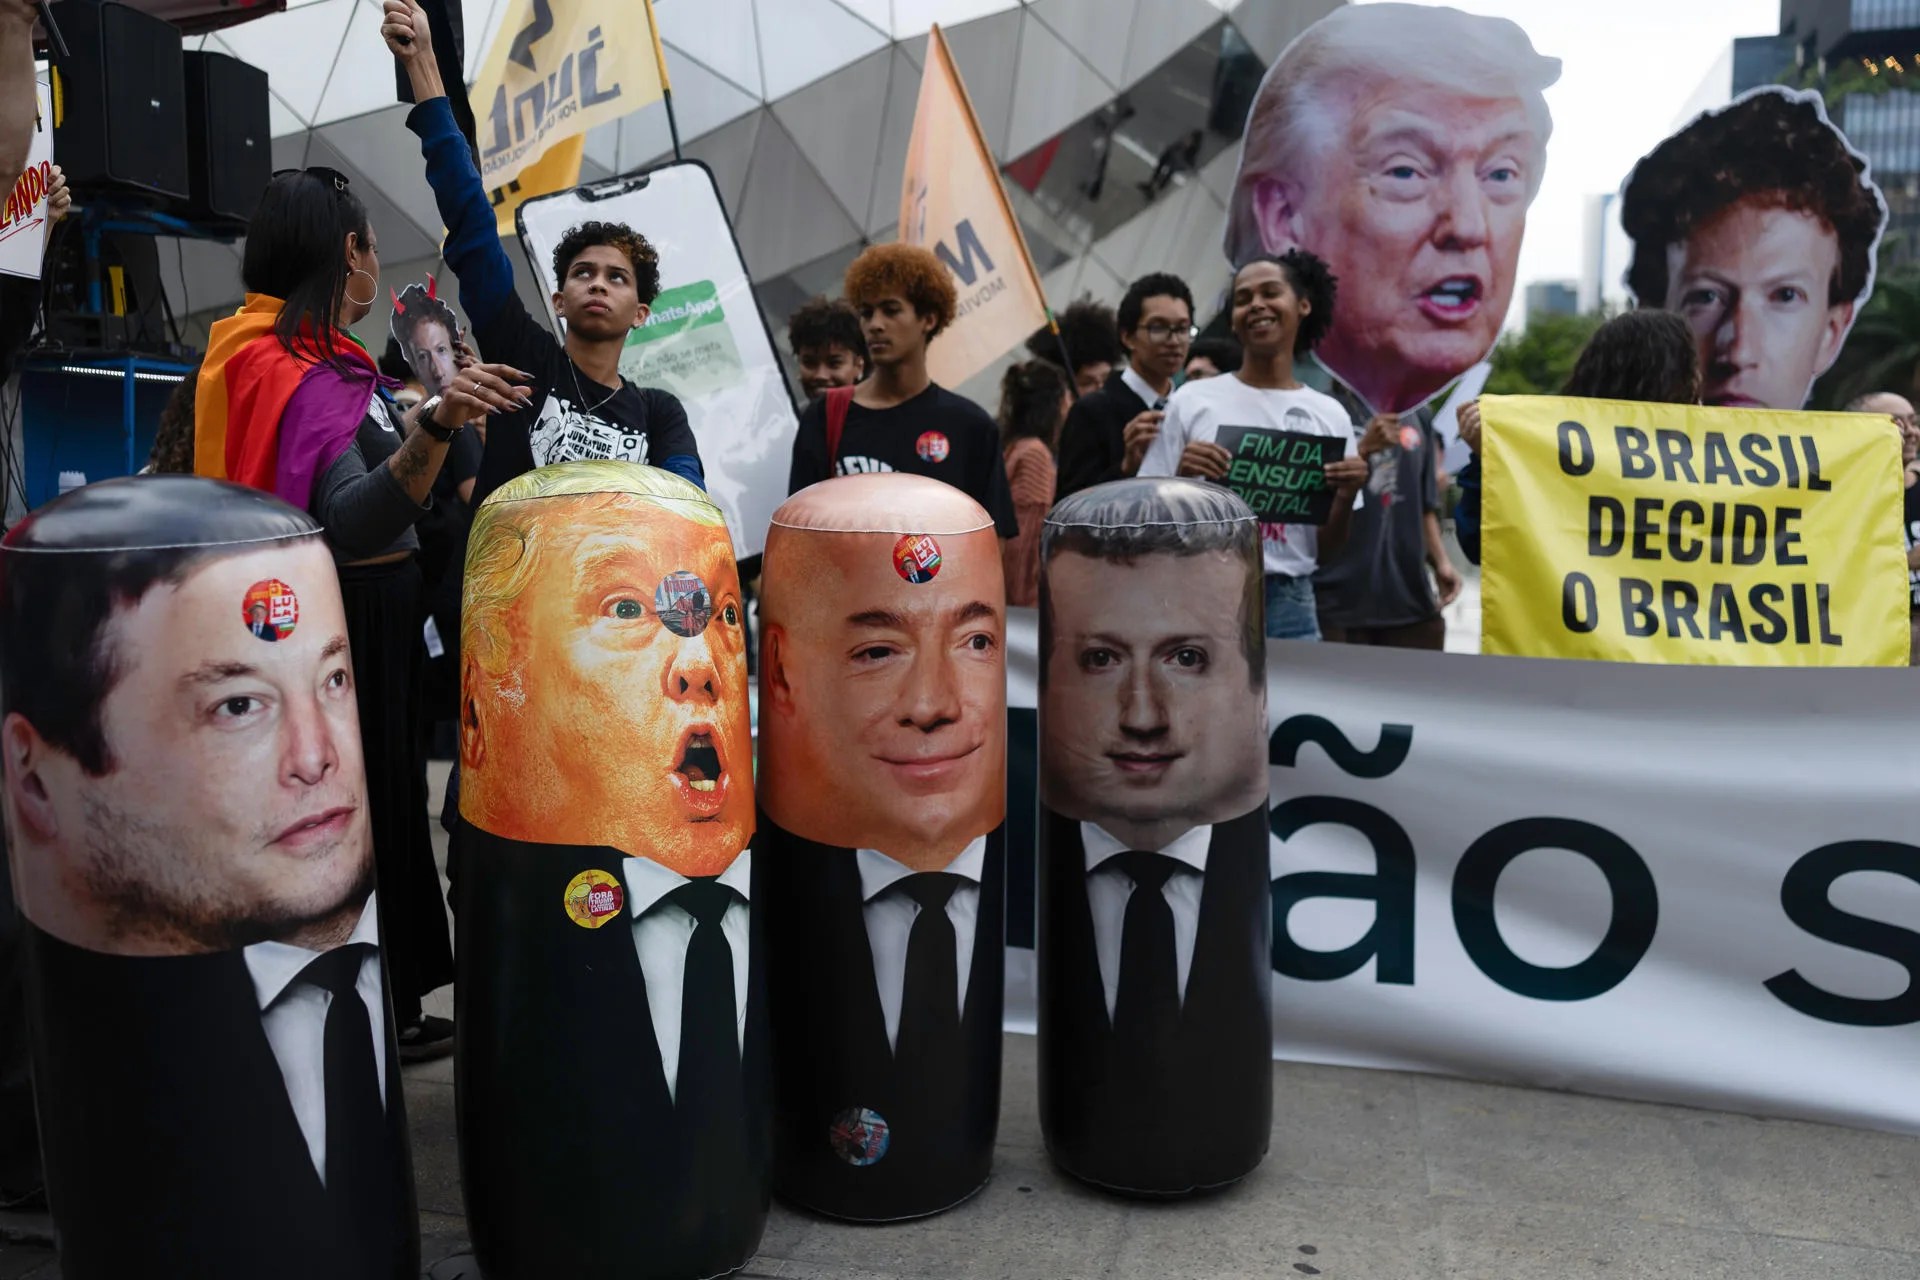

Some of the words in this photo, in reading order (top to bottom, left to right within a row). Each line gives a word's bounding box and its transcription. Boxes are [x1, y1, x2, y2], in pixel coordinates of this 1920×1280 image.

[1227, 459, 1326, 492] ENSUR
[1238, 432, 1288, 460] FIM
[1288, 440, 1323, 467] DA
[1557, 420, 1595, 477] O
[1614, 426, 1832, 491] BRASIL
[1587, 495, 1808, 566] DECIDE
[1562, 571, 1599, 634] O
[1619, 577, 1843, 647] BRASIL
[590, 890, 614, 901] FORA
